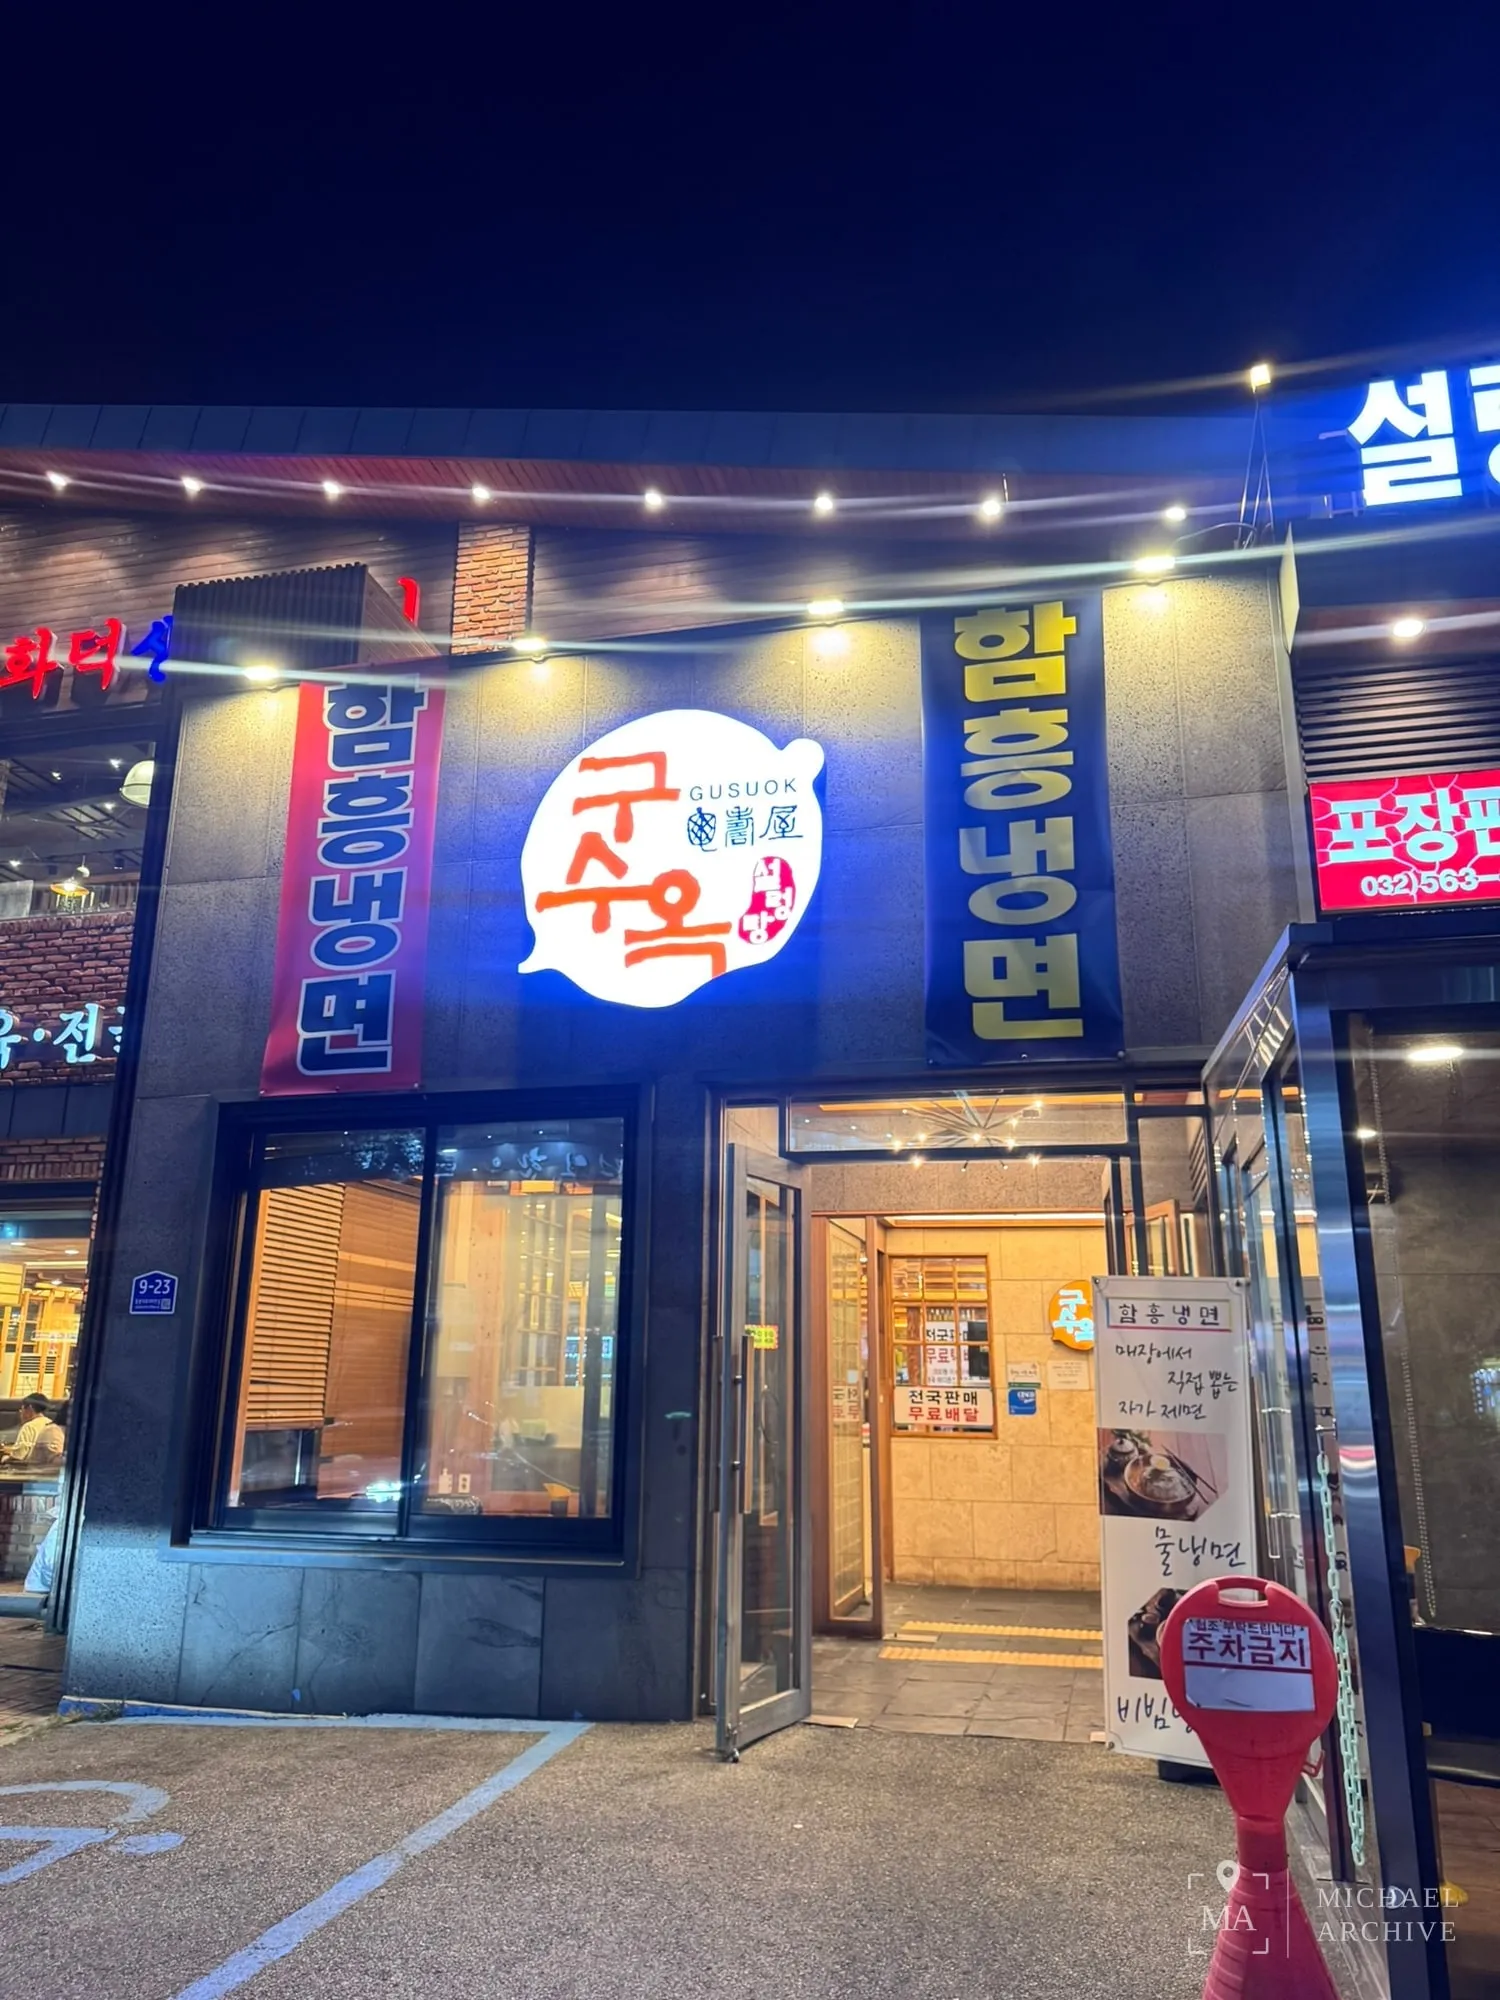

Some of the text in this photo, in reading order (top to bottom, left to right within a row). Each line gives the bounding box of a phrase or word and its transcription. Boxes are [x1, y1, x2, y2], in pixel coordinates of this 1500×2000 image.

[689, 777, 797, 801] GUSUOK
[954, 600, 1084, 1041] 함흥냉면
[297, 674, 429, 1075] 함흥냉면
[534, 751, 733, 978] 구수옥
[139, 1279, 171, 1295] 9-23
[1118, 1303, 1220, 1327] 함흥냉면
[1115, 1342, 1192, 1364] 매장에서
[1167, 1369, 1238, 1400] 직접 뽑는
[908, 1390, 978, 1406] 전국판매
[1118, 1400, 1207, 1420] 자가 제면
[908, 1406, 979, 1422] 무료배달
[1155, 1526, 1246, 1576] 물냉면
[1187, 1632, 1307, 1668] 주차금지
